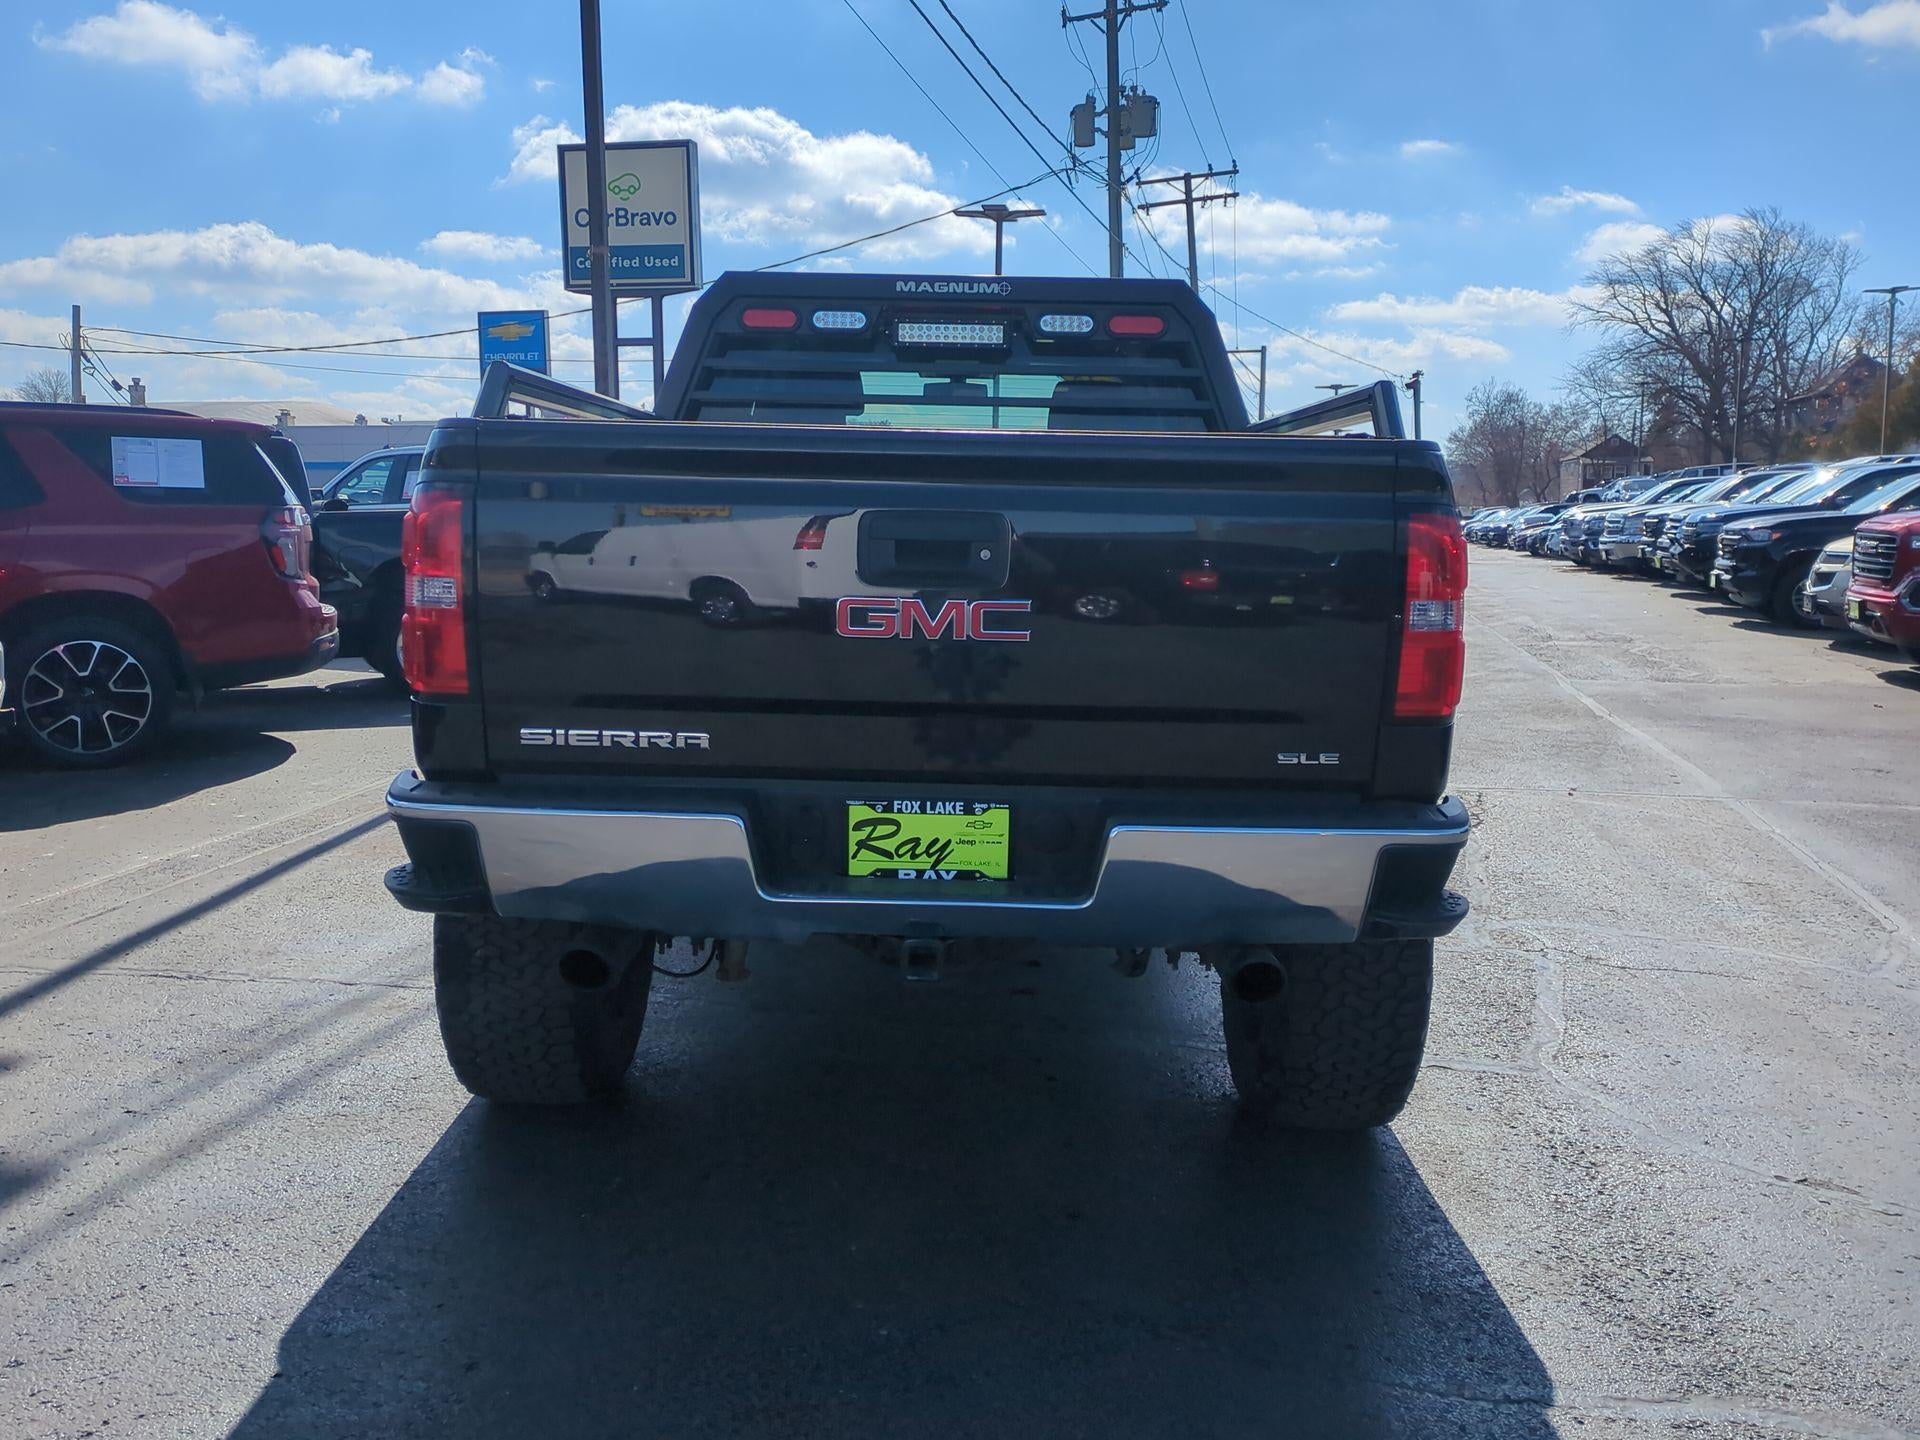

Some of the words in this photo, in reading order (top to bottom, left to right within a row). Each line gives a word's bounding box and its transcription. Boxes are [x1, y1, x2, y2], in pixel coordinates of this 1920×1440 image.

[574, 206, 677, 228] CrBravo
[644, 255, 679, 267] Used
[896, 281, 998, 294] MAGNUM
[484, 352, 540, 361] CHEVROLET
[836, 597, 1032, 642] GMC
[519, 728, 711, 750] SIERRA
[1277, 752, 1340, 764] SLE
[893, 800, 921, 814] FOX
[926, 802, 964, 815] LAKE
[851, 817, 955, 870] Ray
[955, 837, 977, 847] Jeep
